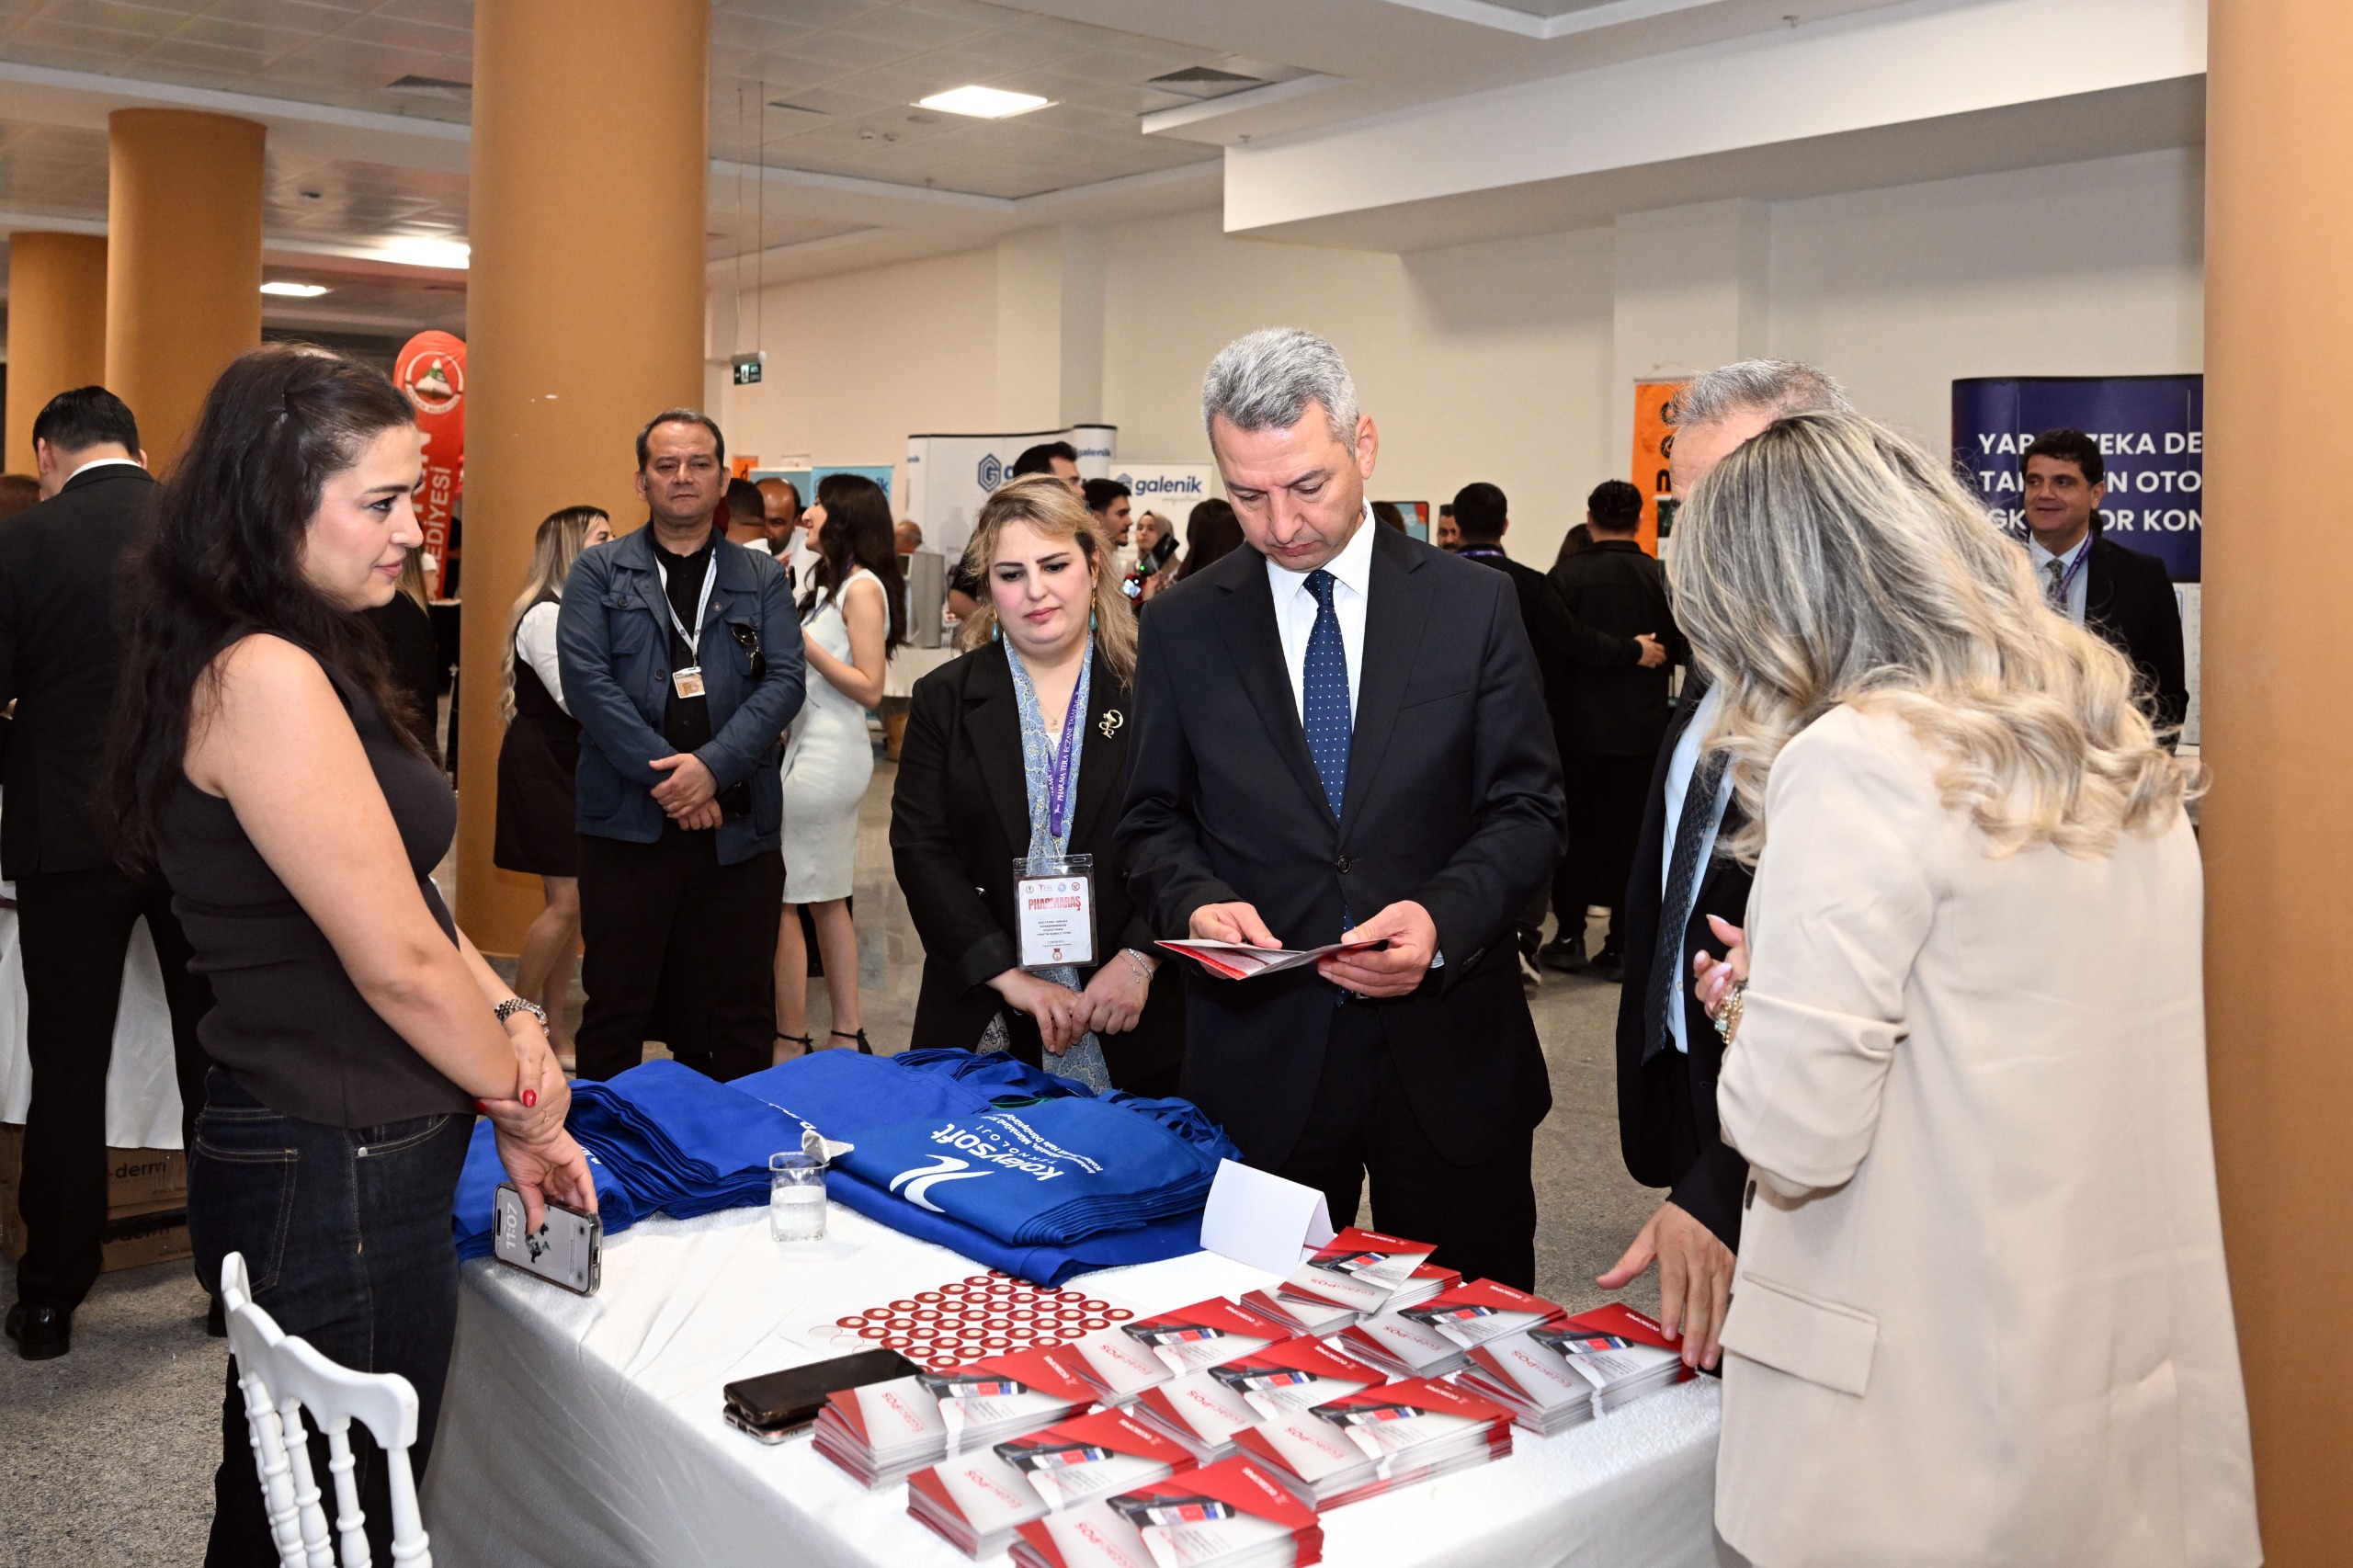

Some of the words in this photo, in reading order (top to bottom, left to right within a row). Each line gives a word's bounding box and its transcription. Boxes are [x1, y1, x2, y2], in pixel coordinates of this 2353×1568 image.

[1978, 434, 2036, 455] YAP
[1136, 476, 1202, 495] galenik
[424, 466, 451, 577] EDİYESİ
[1063, 726, 1074, 753] ECZANE
[1061, 753, 1070, 776] TERA
[1058, 773, 1067, 801] PHARMA
[506, 1202, 517, 1250] 11:07
